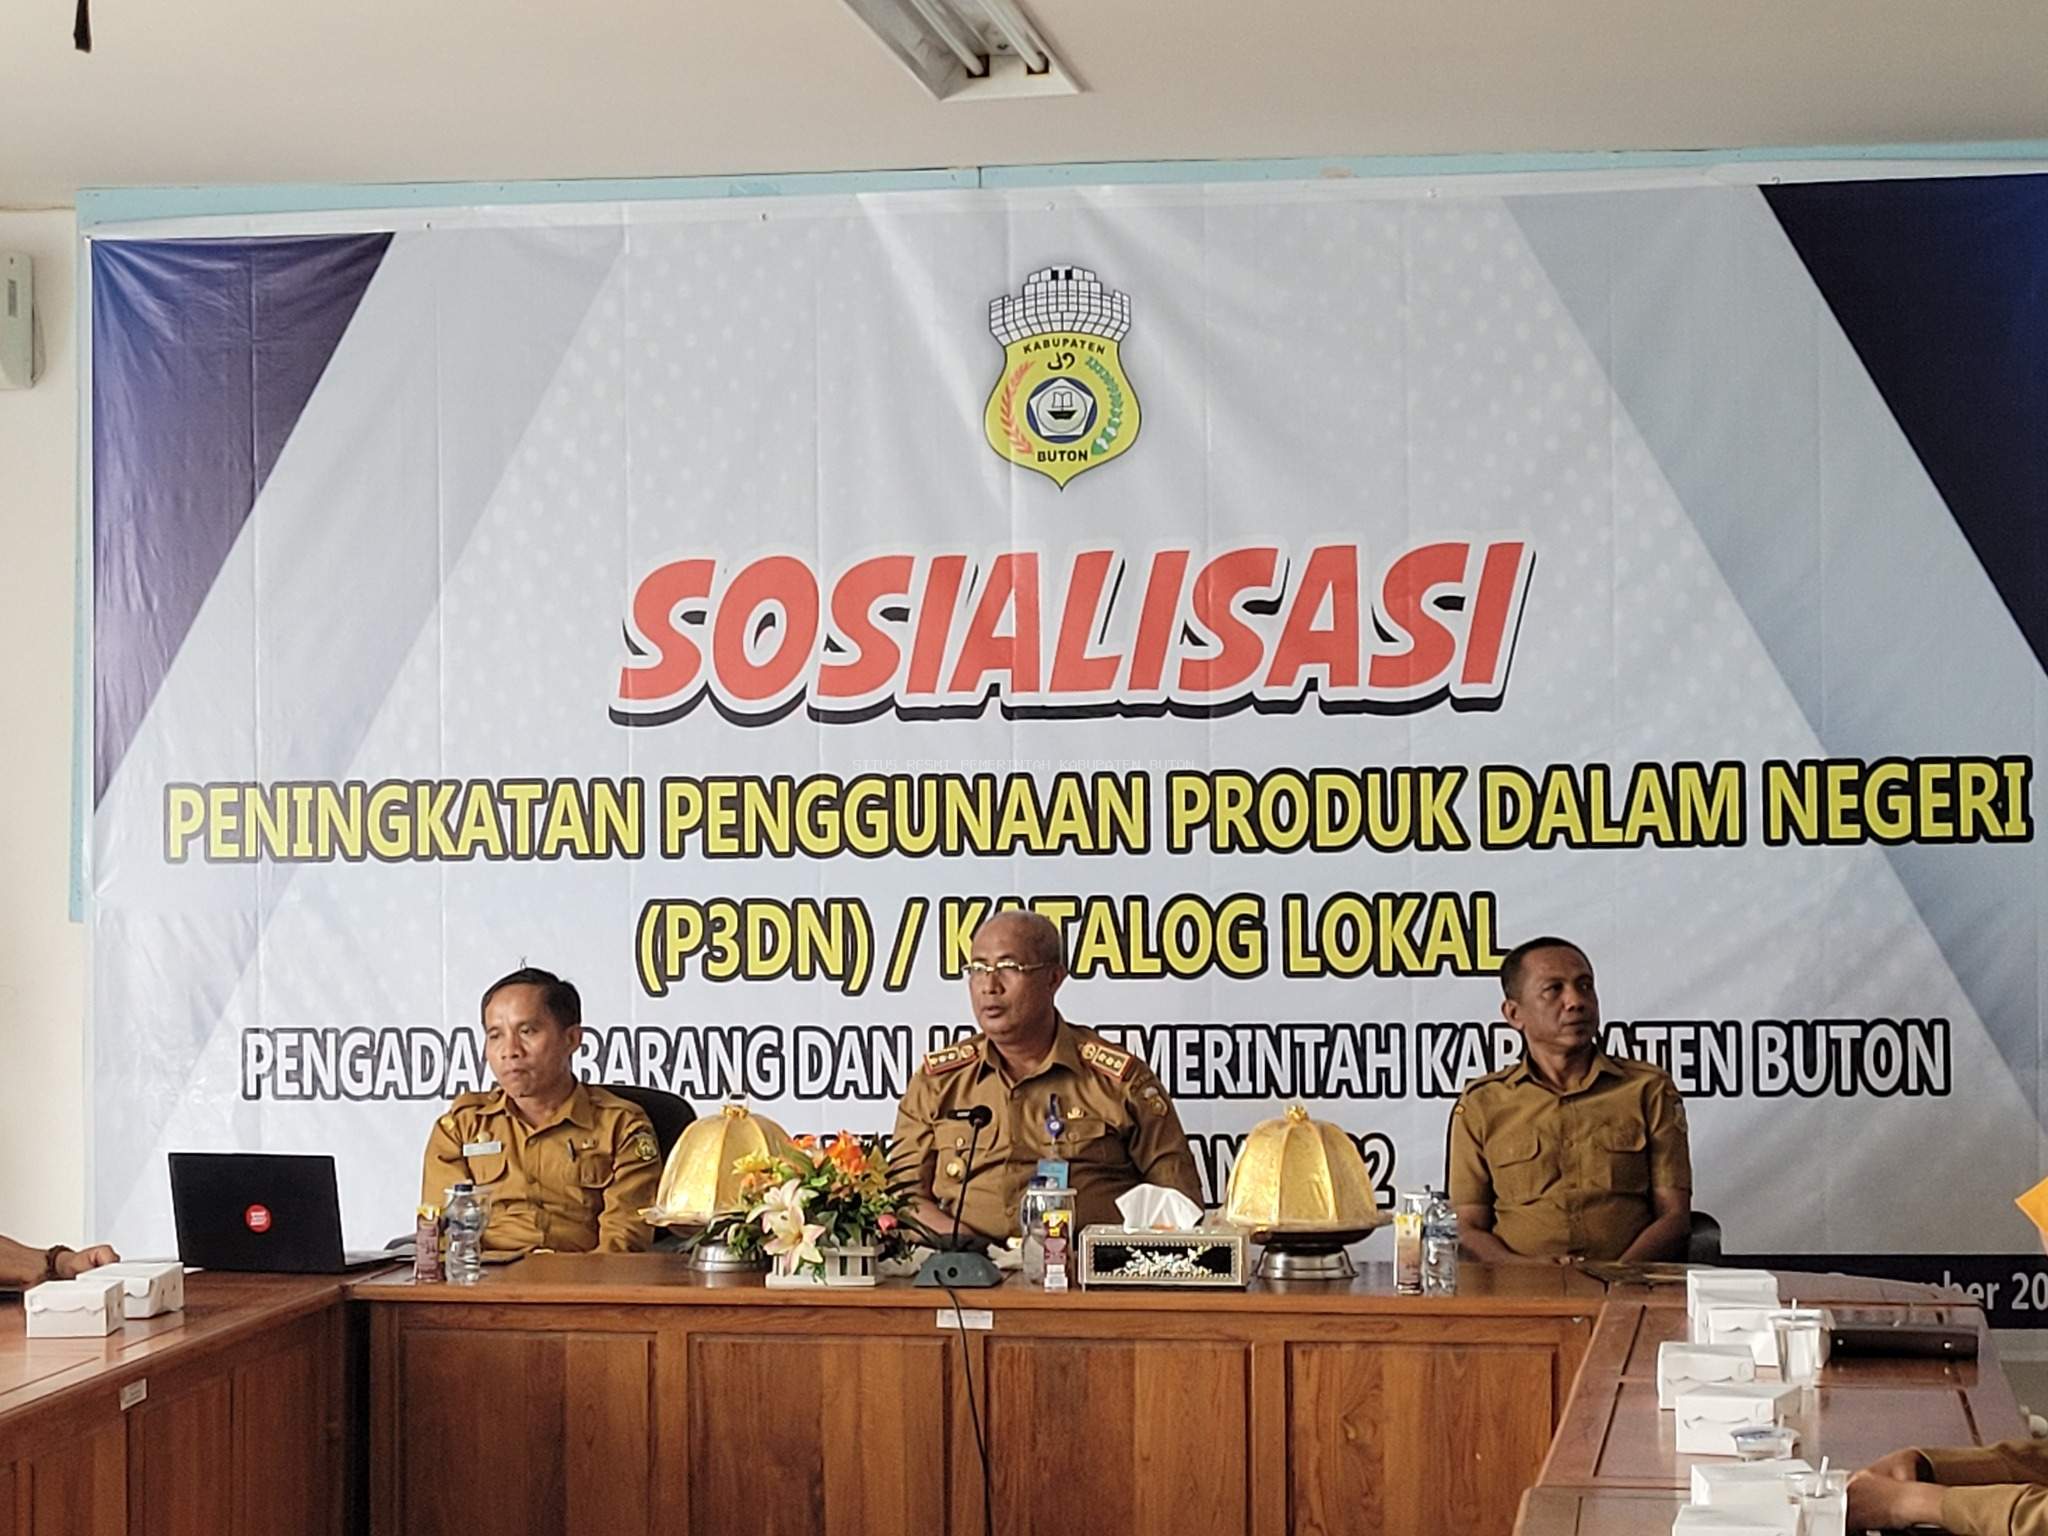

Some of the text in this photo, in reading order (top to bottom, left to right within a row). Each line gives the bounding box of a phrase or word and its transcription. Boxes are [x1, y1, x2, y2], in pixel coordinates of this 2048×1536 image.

[1023, 338, 1105, 355] KABUPATEN
[1037, 450, 1088, 462] BUTON
[611, 541, 1535, 722] SOSIALISASI
[165, 756, 2033, 861] PENINGKATAN PENGGUNAAN PRODUK DALAM NEGERI
[637, 891, 1510, 995] (P3DN) / KTALOG LOKAL
[243, 1025, 500, 1101] PENGADA
[793, 1025, 913, 1098] DAN
[1096, 1023, 1410, 1099] MERINTAH
[1752, 1018, 1953, 1097] BUTON
[2011, 1272, 2048, 1311] 20
